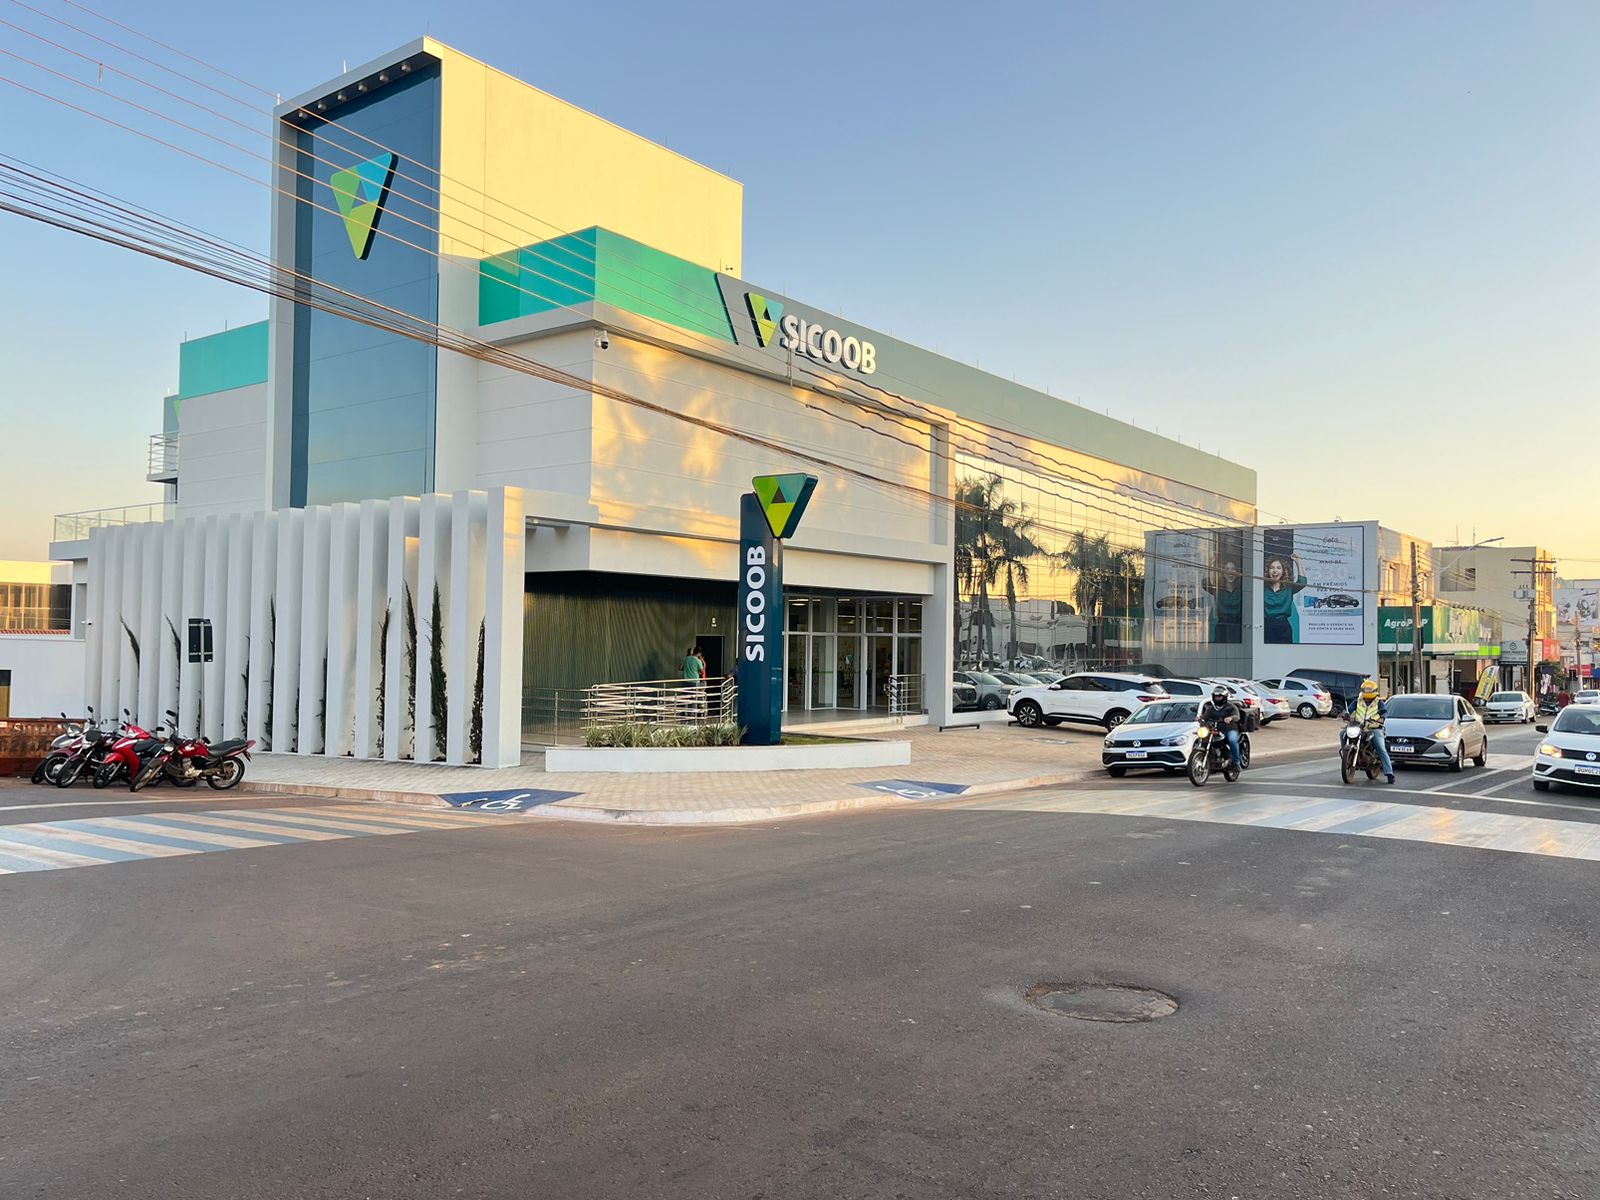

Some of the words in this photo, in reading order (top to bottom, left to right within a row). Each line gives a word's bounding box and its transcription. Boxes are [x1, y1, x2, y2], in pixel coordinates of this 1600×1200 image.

[780, 314, 877, 375] SICOOB
[746, 545, 766, 662] SICOOB
[1384, 618, 1428, 629] AgroPP
